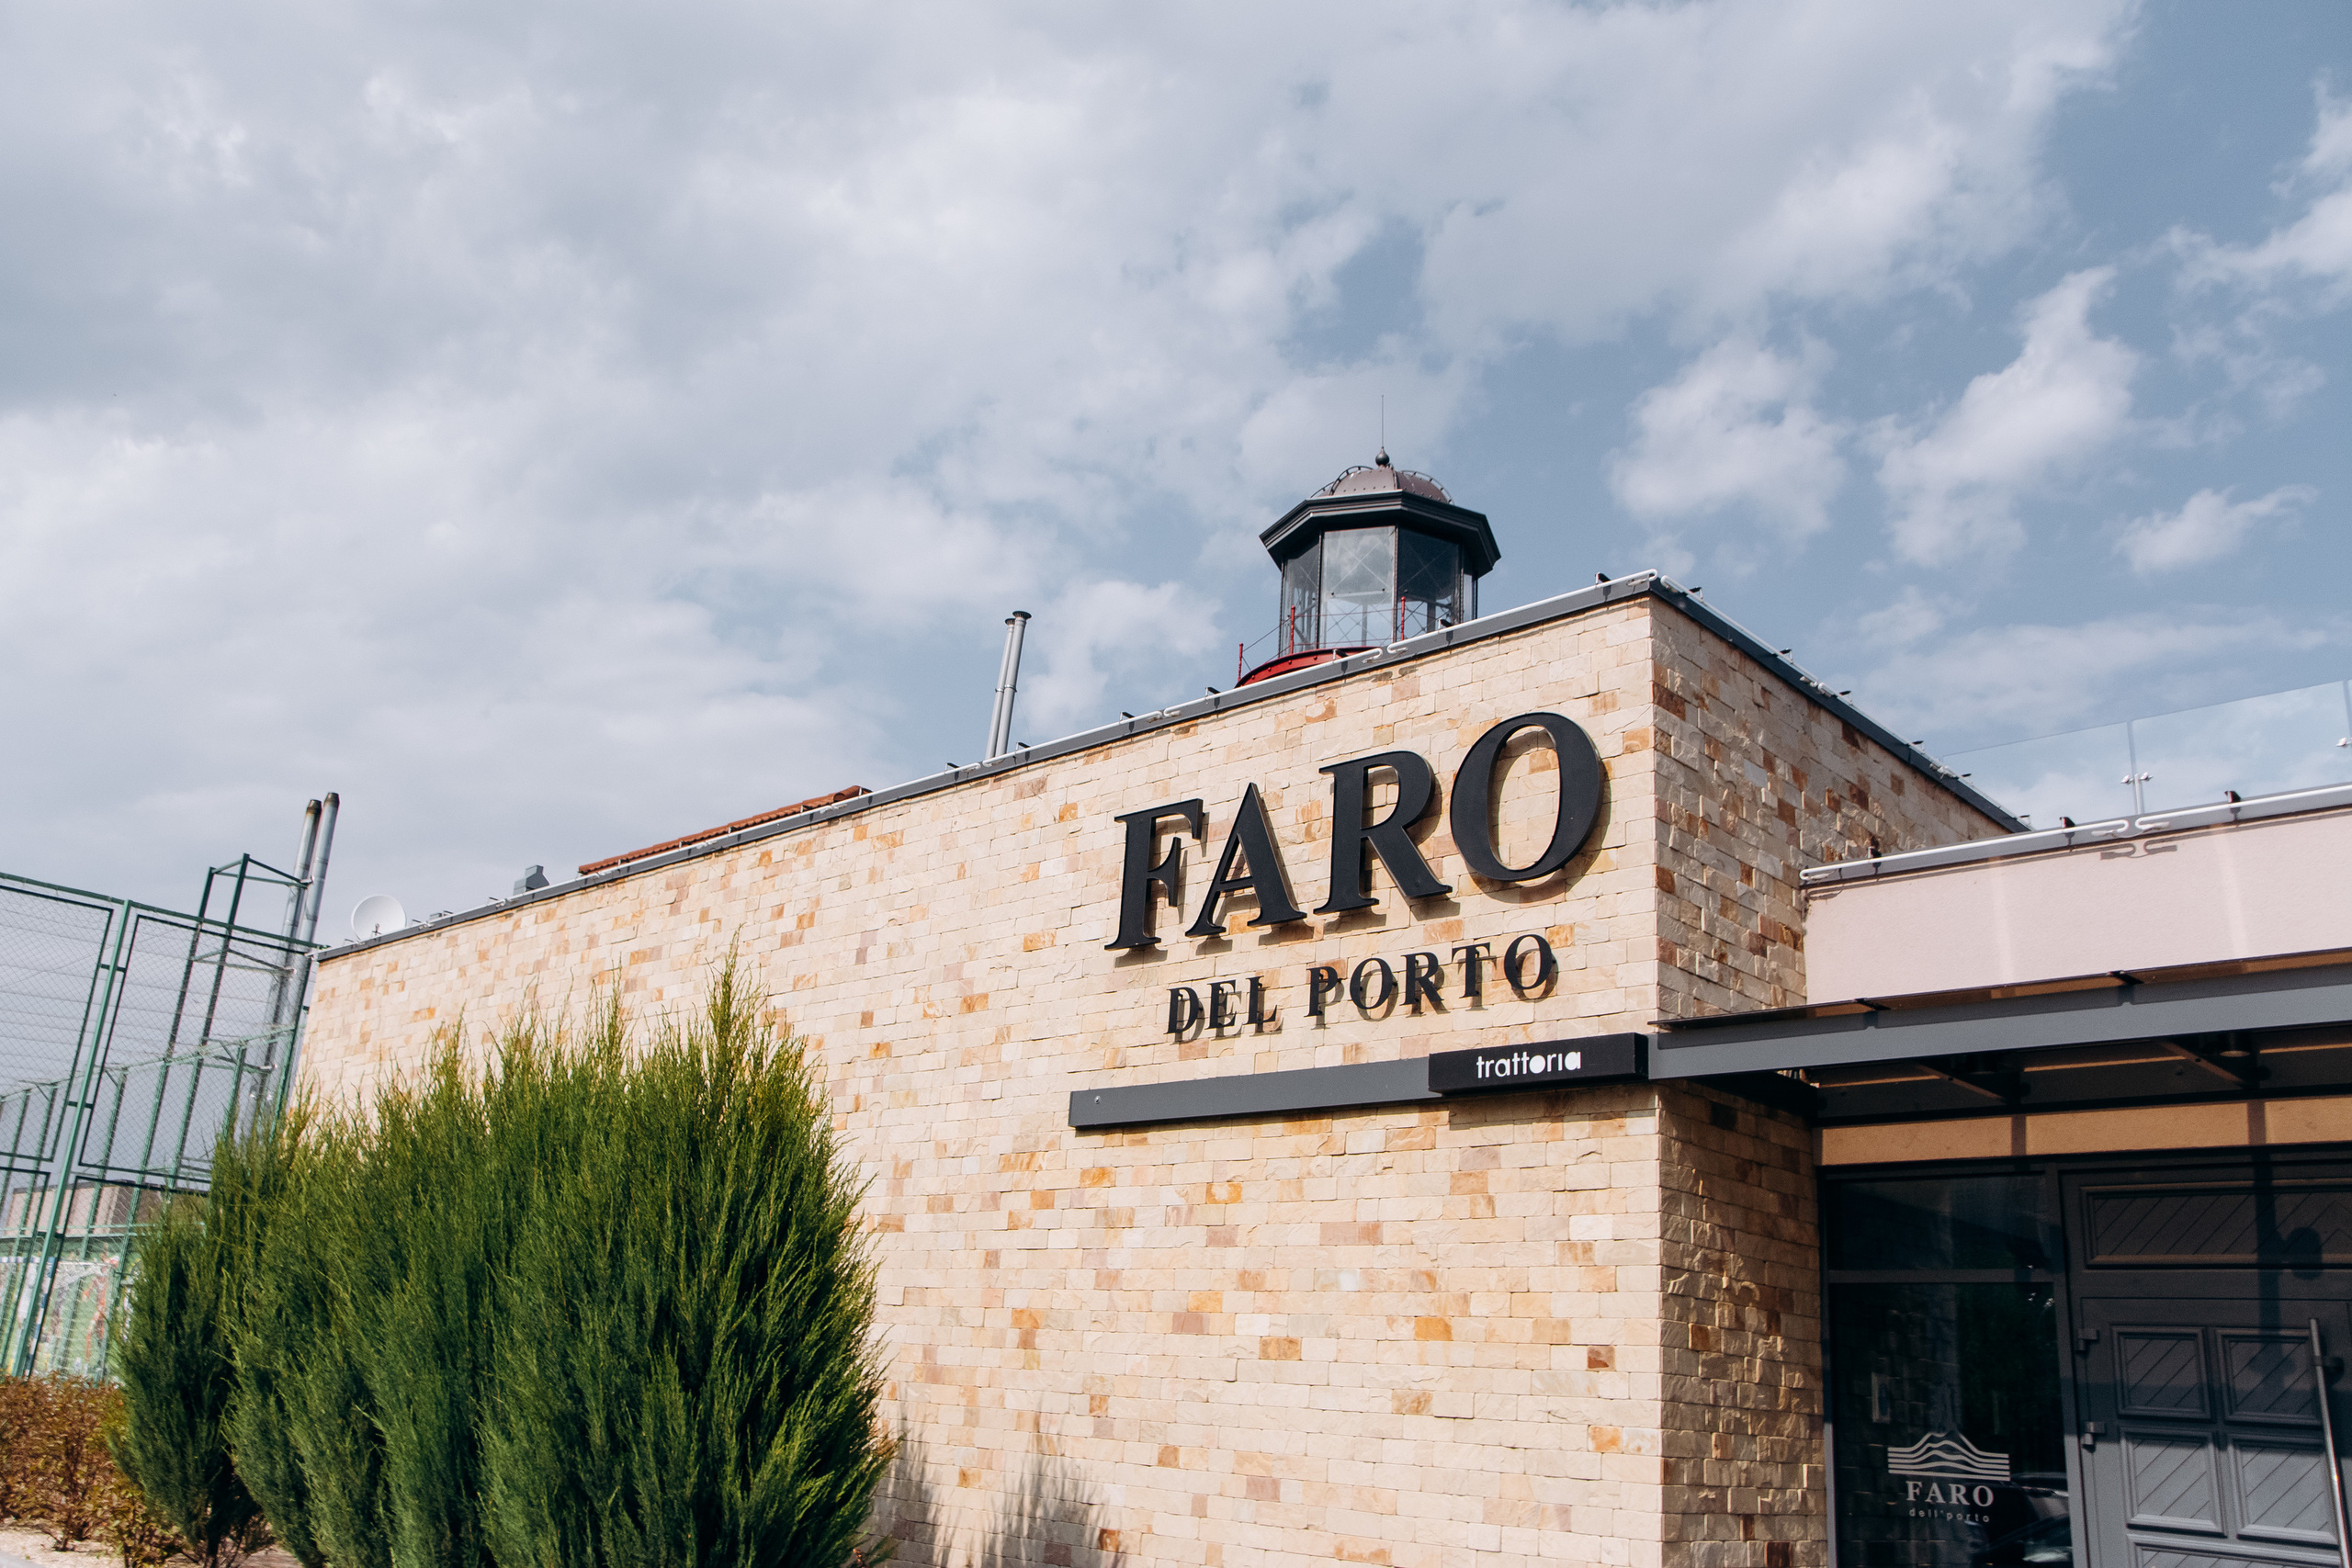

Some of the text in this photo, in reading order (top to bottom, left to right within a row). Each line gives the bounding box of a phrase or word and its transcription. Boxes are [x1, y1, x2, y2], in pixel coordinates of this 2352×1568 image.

[1104, 711, 1602, 951] FARO
[1164, 933, 1554, 1035] DEL PORTO
[1476, 1051, 1581, 1078] trattoria
[1905, 1480, 1995, 1507] FARO
